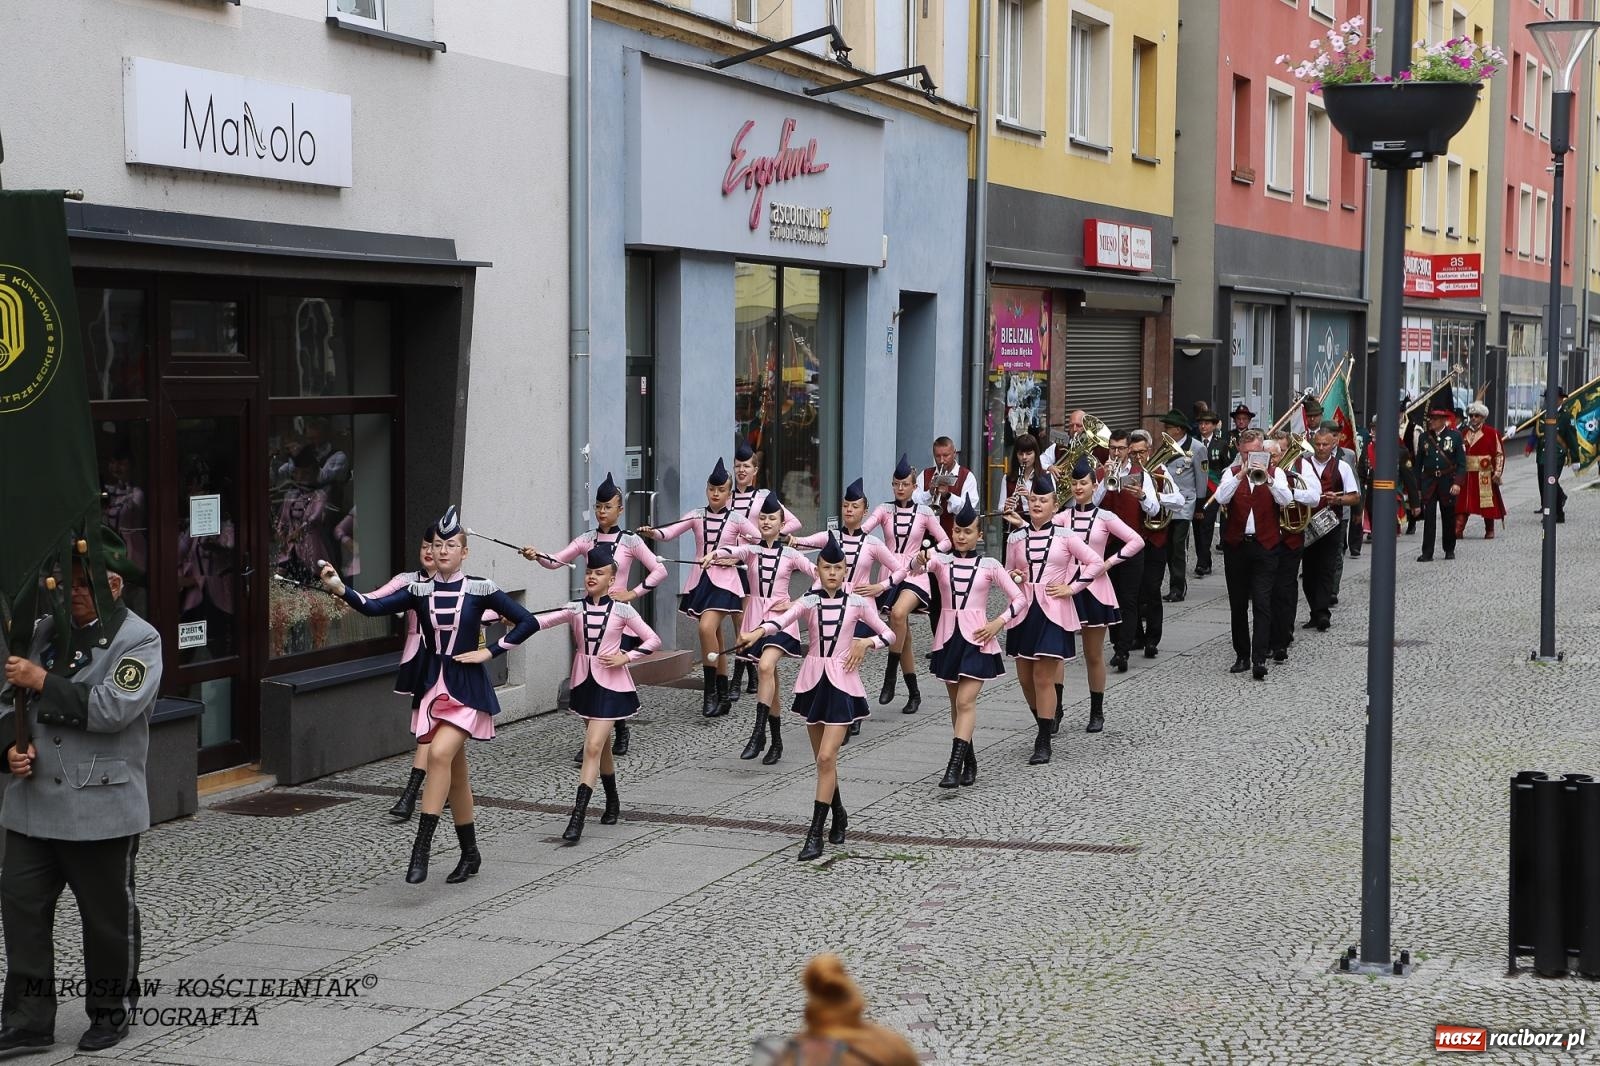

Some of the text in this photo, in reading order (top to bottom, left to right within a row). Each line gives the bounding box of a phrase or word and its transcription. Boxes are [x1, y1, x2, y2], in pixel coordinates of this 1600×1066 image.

[183, 89, 316, 166] Manolo
[1450, 256, 1464, 267] as
[11, 275, 55, 332] KURKOWE
[1001, 327, 1034, 344] BIELIZNA
[1001, 347, 1018, 356] Damska
[0, 345, 55, 404] TRZELECKIE
